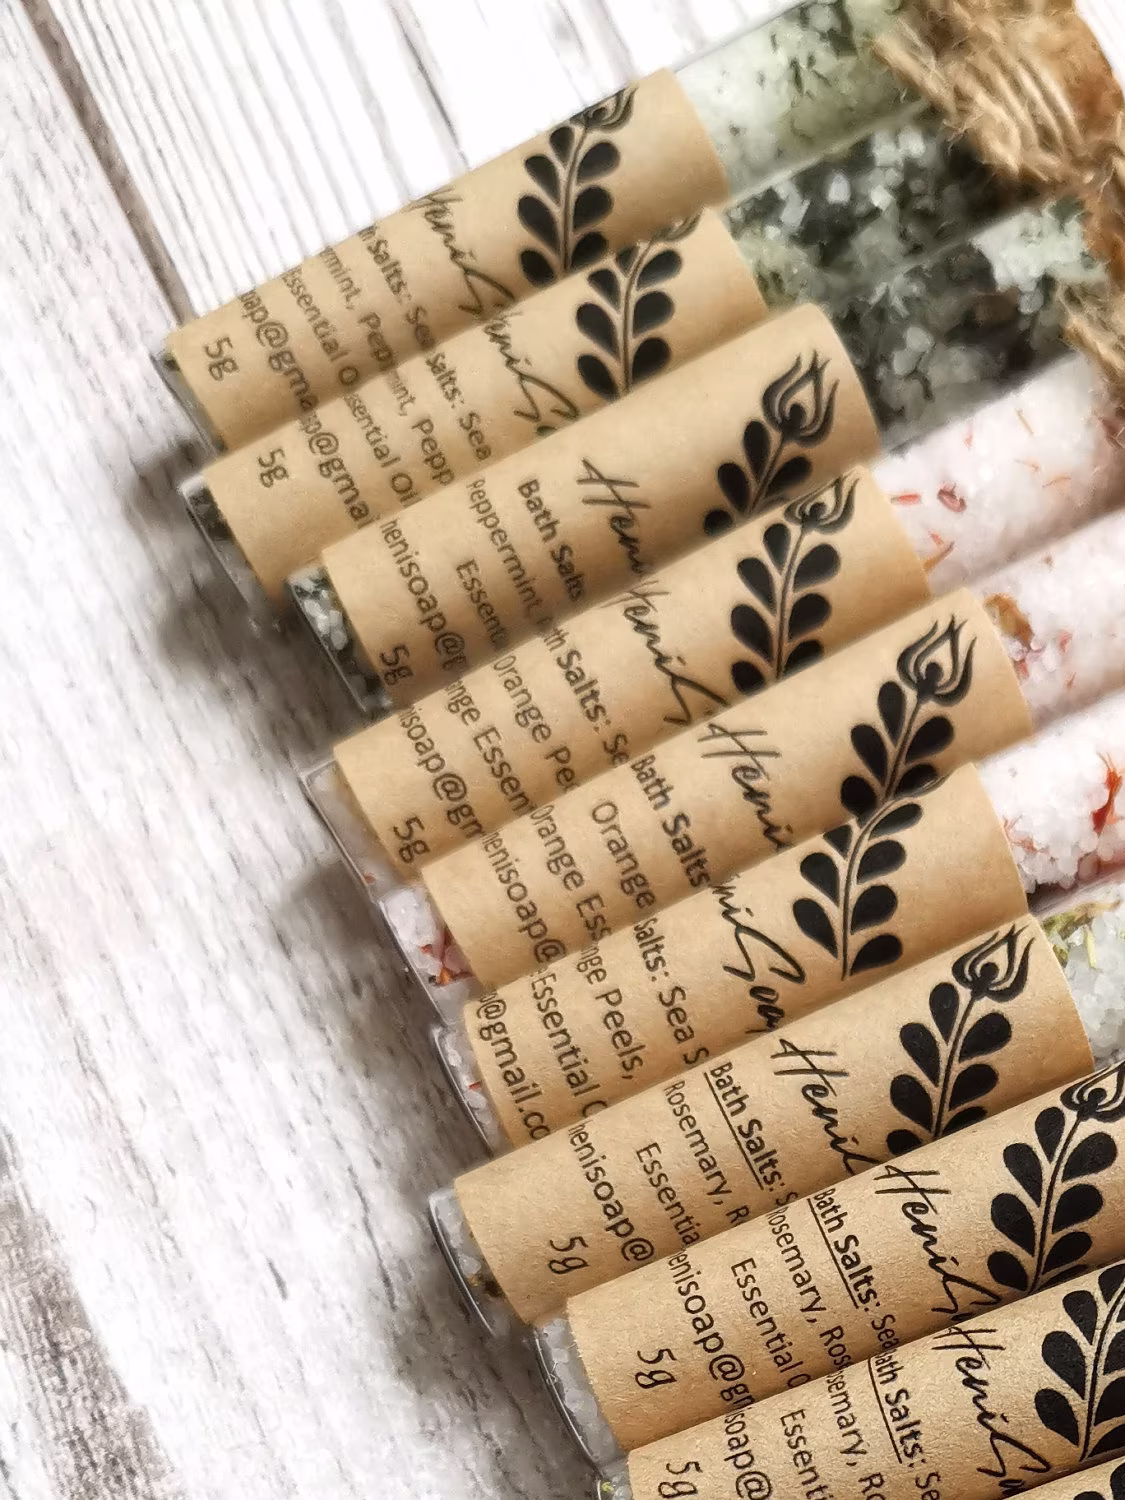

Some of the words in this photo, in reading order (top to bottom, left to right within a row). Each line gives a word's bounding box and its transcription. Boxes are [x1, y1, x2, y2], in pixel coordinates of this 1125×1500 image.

[205, 337, 239, 382] 5g
[258, 447, 289, 489] 5g
[459, 411, 491, 461] Sea
[517, 478, 560, 543] Bath
[379, 643, 414, 686] 5g
[493, 654, 551, 744] Orange
[555, 649, 612, 734] Salts:
[603, 733, 630, 767] Se
[630, 754, 674, 811] Bath
[393, 815, 430, 865] 5g
[530, 804, 585, 892] Orange
[591, 799, 657, 909] Orange
[633, 917, 670, 982] Salts:
[658, 985, 695, 1045] Sea
[531, 972, 601, 1098] Essential
[595, 988, 646, 1081] Peels,
[664, 1080, 733, 1206] Rosemary,
[710, 1061, 749, 1117] Bath
[737, 1118, 786, 1192] Salts:
[549, 1235, 589, 1275] 5g
[767, 1207, 826, 1324] Rosemary,
[814, 1188, 850, 1235] Bath
[833, 1235, 881, 1312] Salts:
[871, 1313, 900, 1351] Sea
[731, 1257, 804, 1373] Essential
[634, 1348, 678, 1390] 5g
[884, 1388, 928, 1469] Salts:
[658, 1460, 702, 1499] 5g
